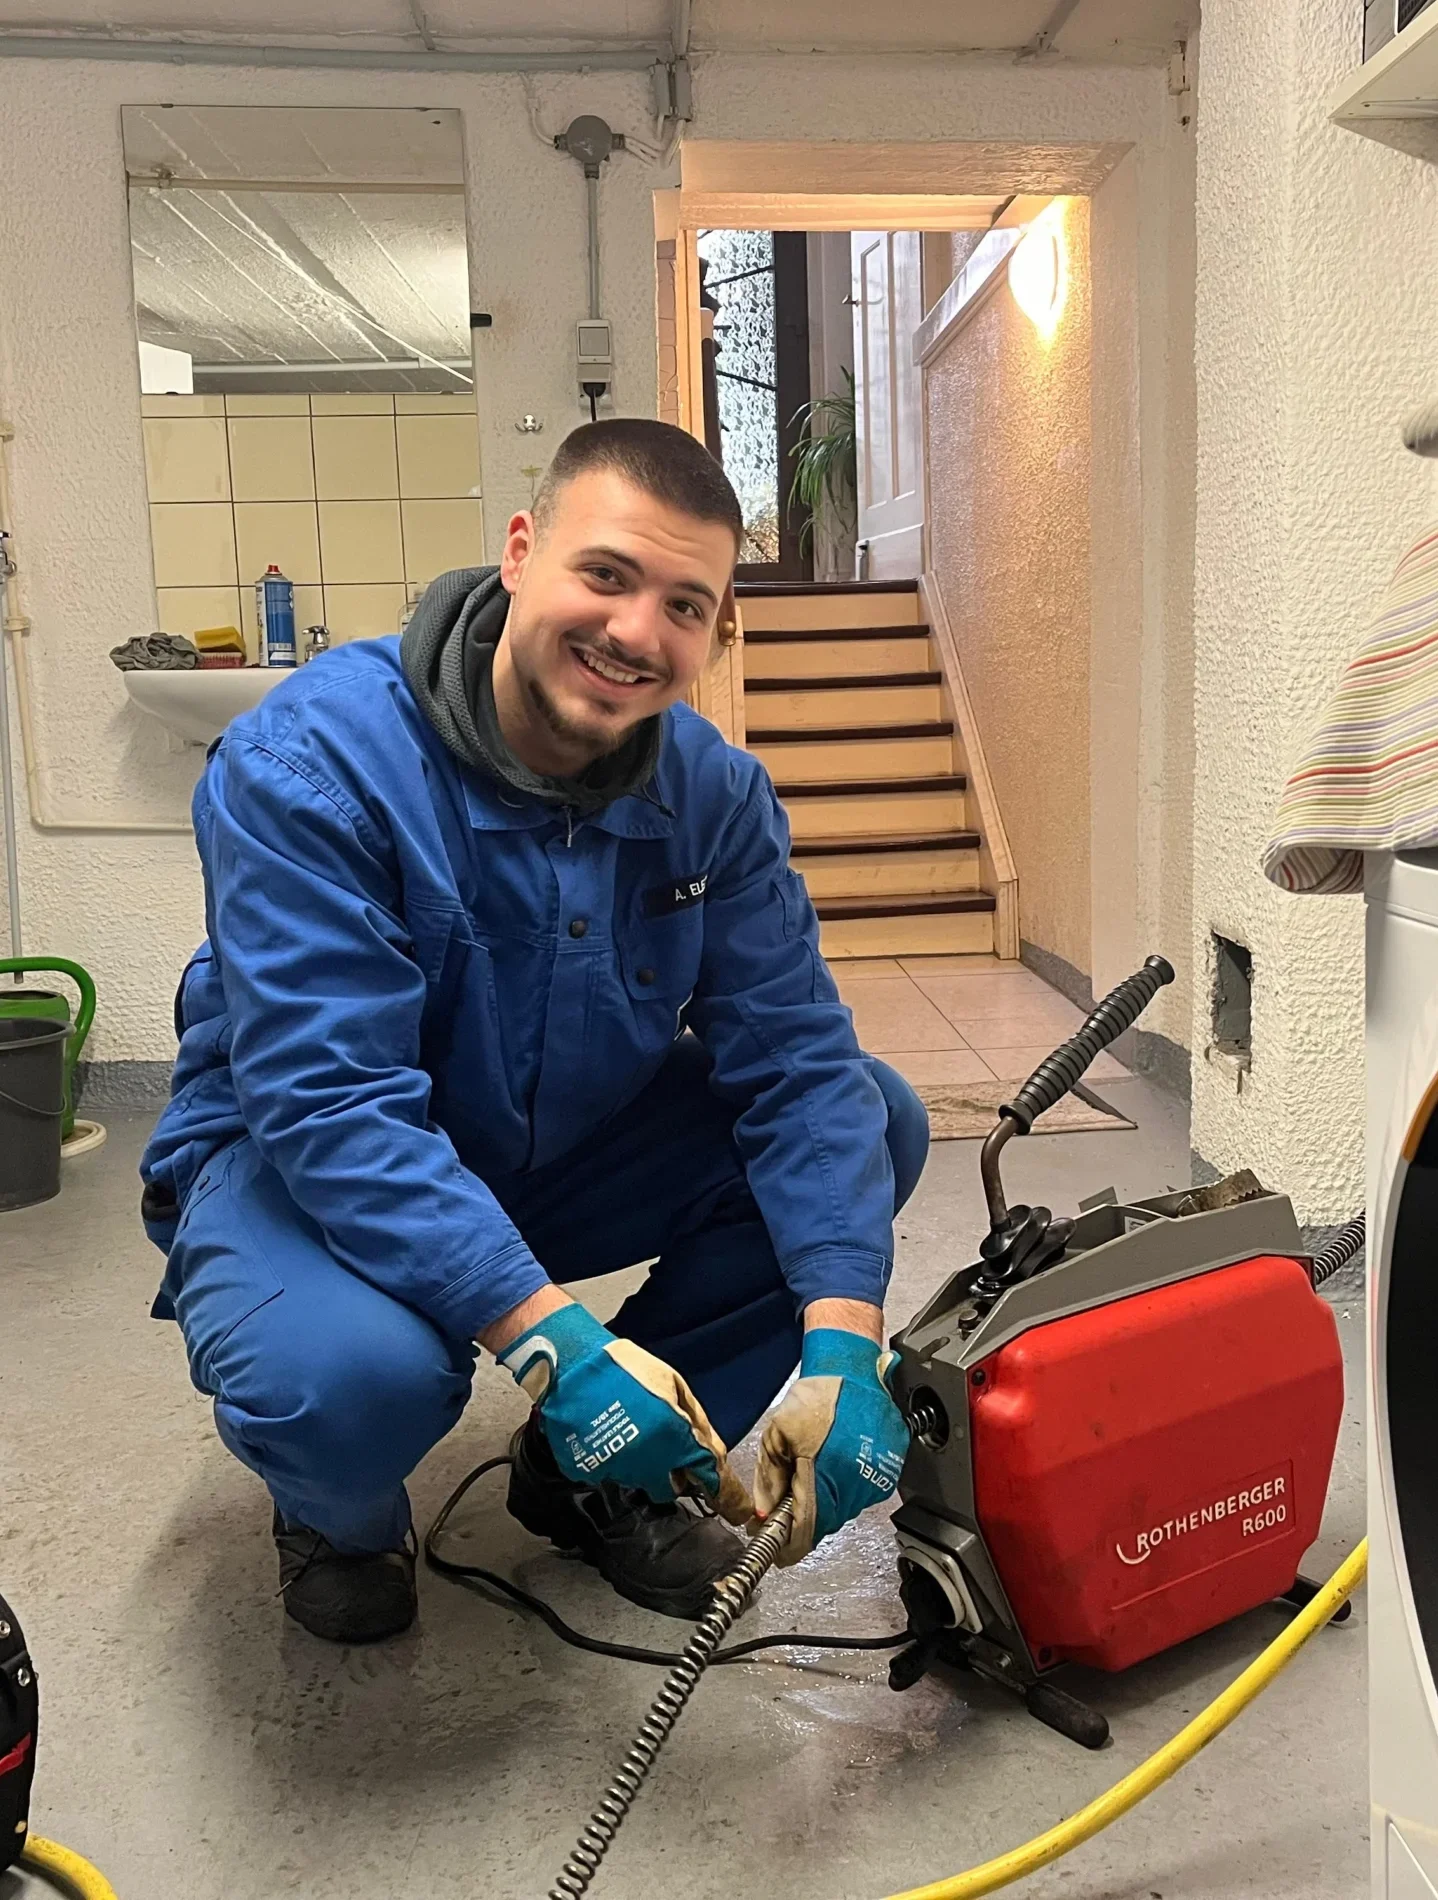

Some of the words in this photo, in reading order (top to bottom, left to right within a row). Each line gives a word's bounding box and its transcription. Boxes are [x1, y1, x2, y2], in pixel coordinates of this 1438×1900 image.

[675, 888, 687, 901] A.
[576, 1423, 640, 1472] CONEL
[856, 1458, 894, 1492] CONEL
[1136, 1477, 1286, 1553] ROTHENBERGER
[1242, 1504, 1287, 1537] R600
